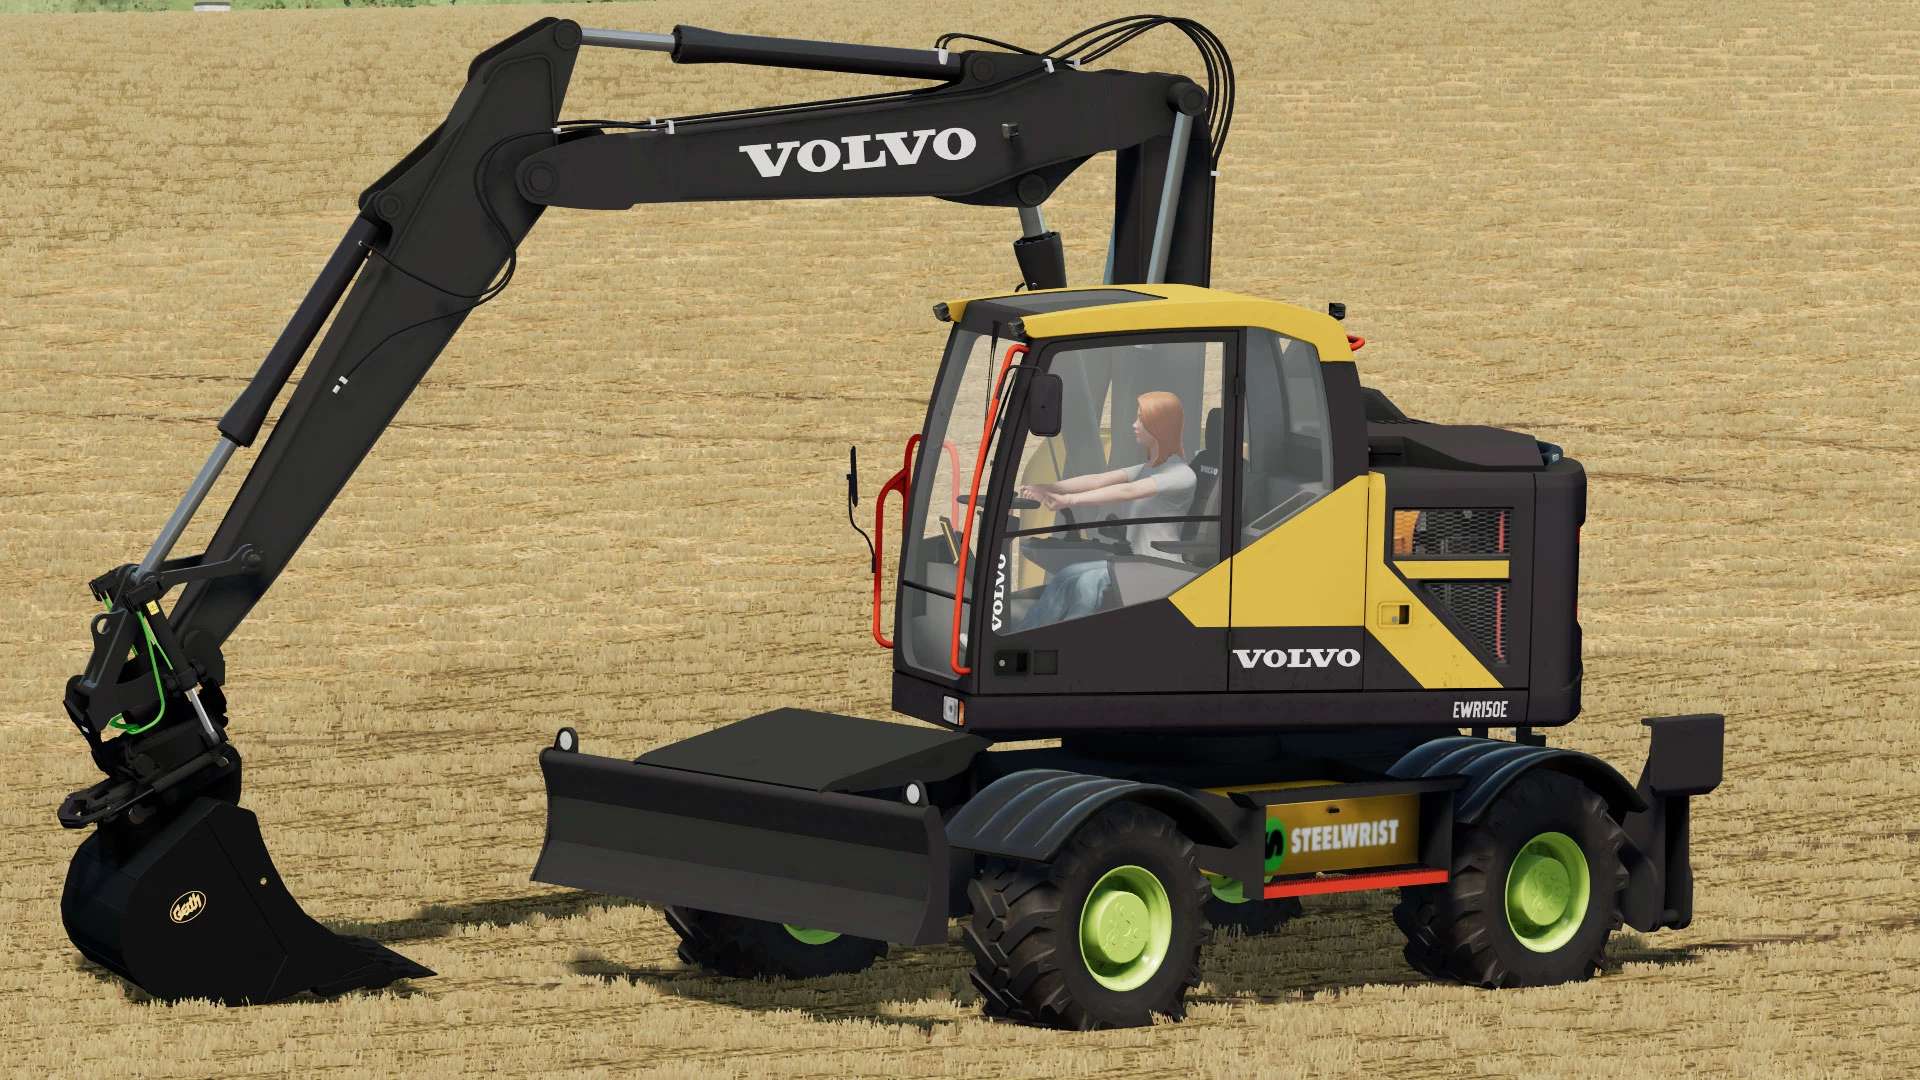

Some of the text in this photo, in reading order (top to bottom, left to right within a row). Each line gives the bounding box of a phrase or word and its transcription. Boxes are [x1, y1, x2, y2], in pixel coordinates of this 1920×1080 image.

[739, 127, 977, 178] VOLVO
[991, 553, 1007, 632] VOLVO
[1232, 648, 1361, 668] VOLVO
[1452, 701, 1509, 718] EWR150E
[1291, 819, 1399, 855] STEELWRIST
